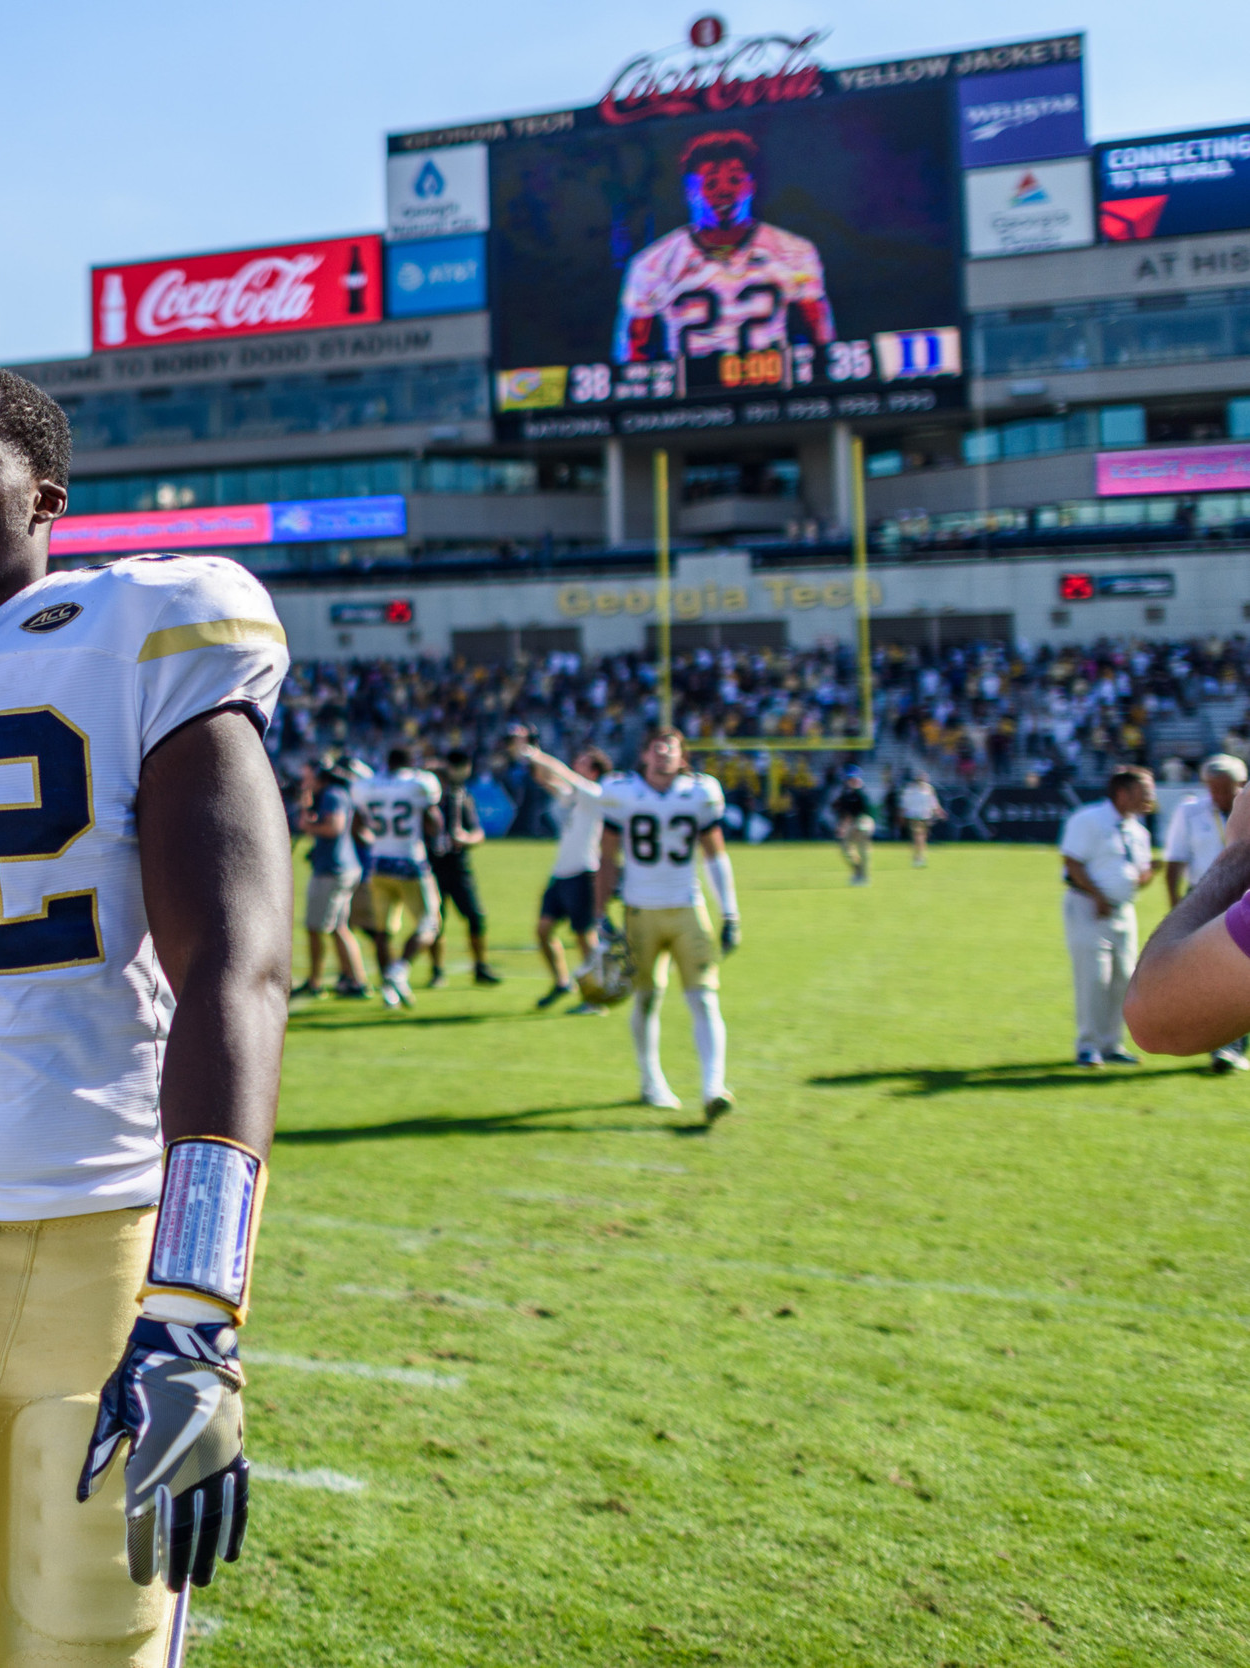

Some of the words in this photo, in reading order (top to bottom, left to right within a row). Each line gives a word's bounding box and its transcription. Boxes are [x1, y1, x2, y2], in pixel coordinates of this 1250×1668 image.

[837, 57, 950, 92] YELLOW
[954, 39, 1080, 76] JACKETS
[404, 121, 507, 149] GEORGIA
[511, 110, 574, 137] TECH
[1108, 134, 1250, 171] CONNECTING
[1136, 165, 1168, 187] THE
[428, 259, 478, 284] AT&T
[1135, 251, 1178, 280] AT
[135, 253, 325, 337] Coca-Cola
[317, 330, 432, 362] STADIUM
[826, 340, 872, 382] 35
[569, 363, 611, 403] 38
[719, 351, 783, 388] 0:00
[29, 605, 73, 626] ACC
[557, 580, 748, 621] Geogia
[367, 800, 412, 837] 52
[628, 813, 699, 867] 83
